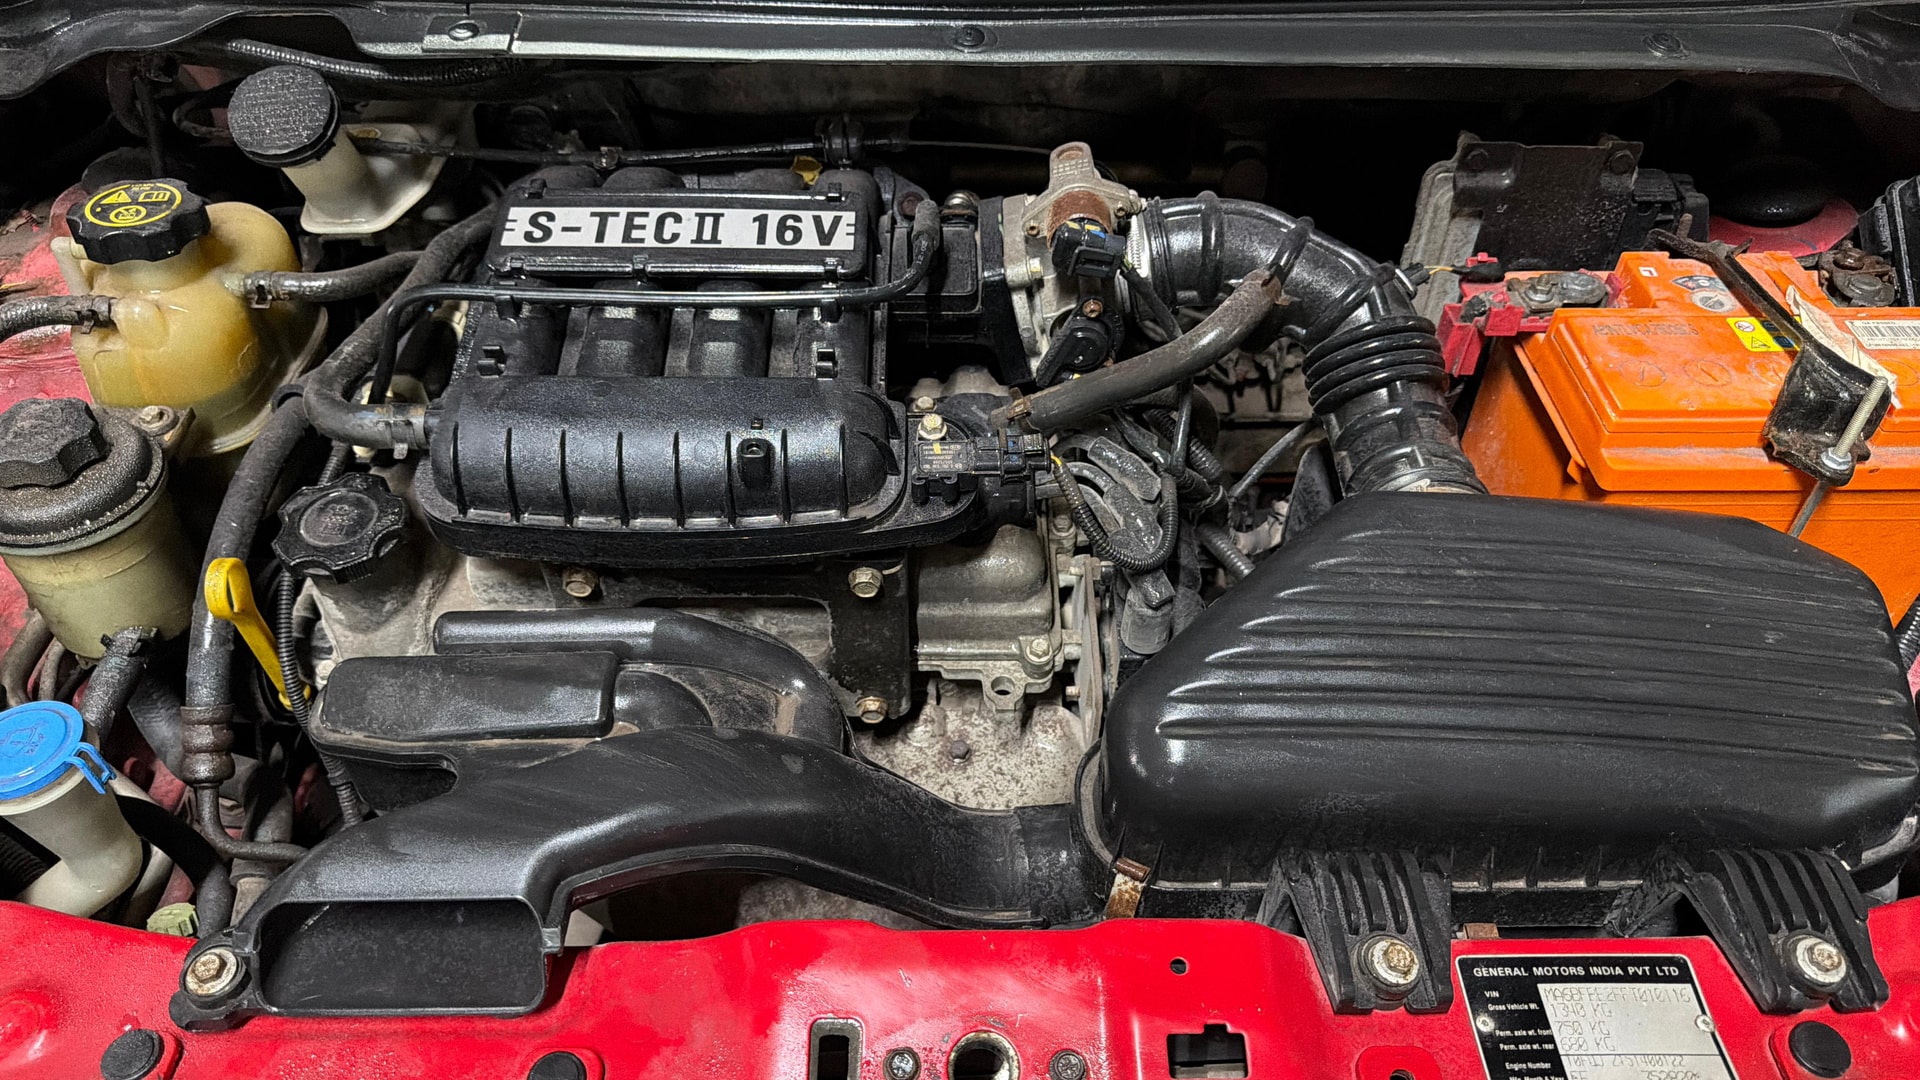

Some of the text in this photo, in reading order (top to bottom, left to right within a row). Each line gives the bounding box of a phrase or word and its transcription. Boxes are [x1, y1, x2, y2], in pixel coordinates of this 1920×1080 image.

[752, 213, 843, 246] 16V
[1473, 966, 1680, 977] GENERAL MOTORS INDIA PVT LTD
[1484, 990, 1500, 998] VIN
[1487, 1003, 1506, 1011] Gross
[1507, 1002, 1529, 1011] Vehicle
[1550, 1003, 1613, 1018] 1340 KG
[1554, 1020, 1611, 1035] 750 KG
[1594, 1036, 1616, 1051] KG
[1505, 1062, 1527, 1071] Engine
